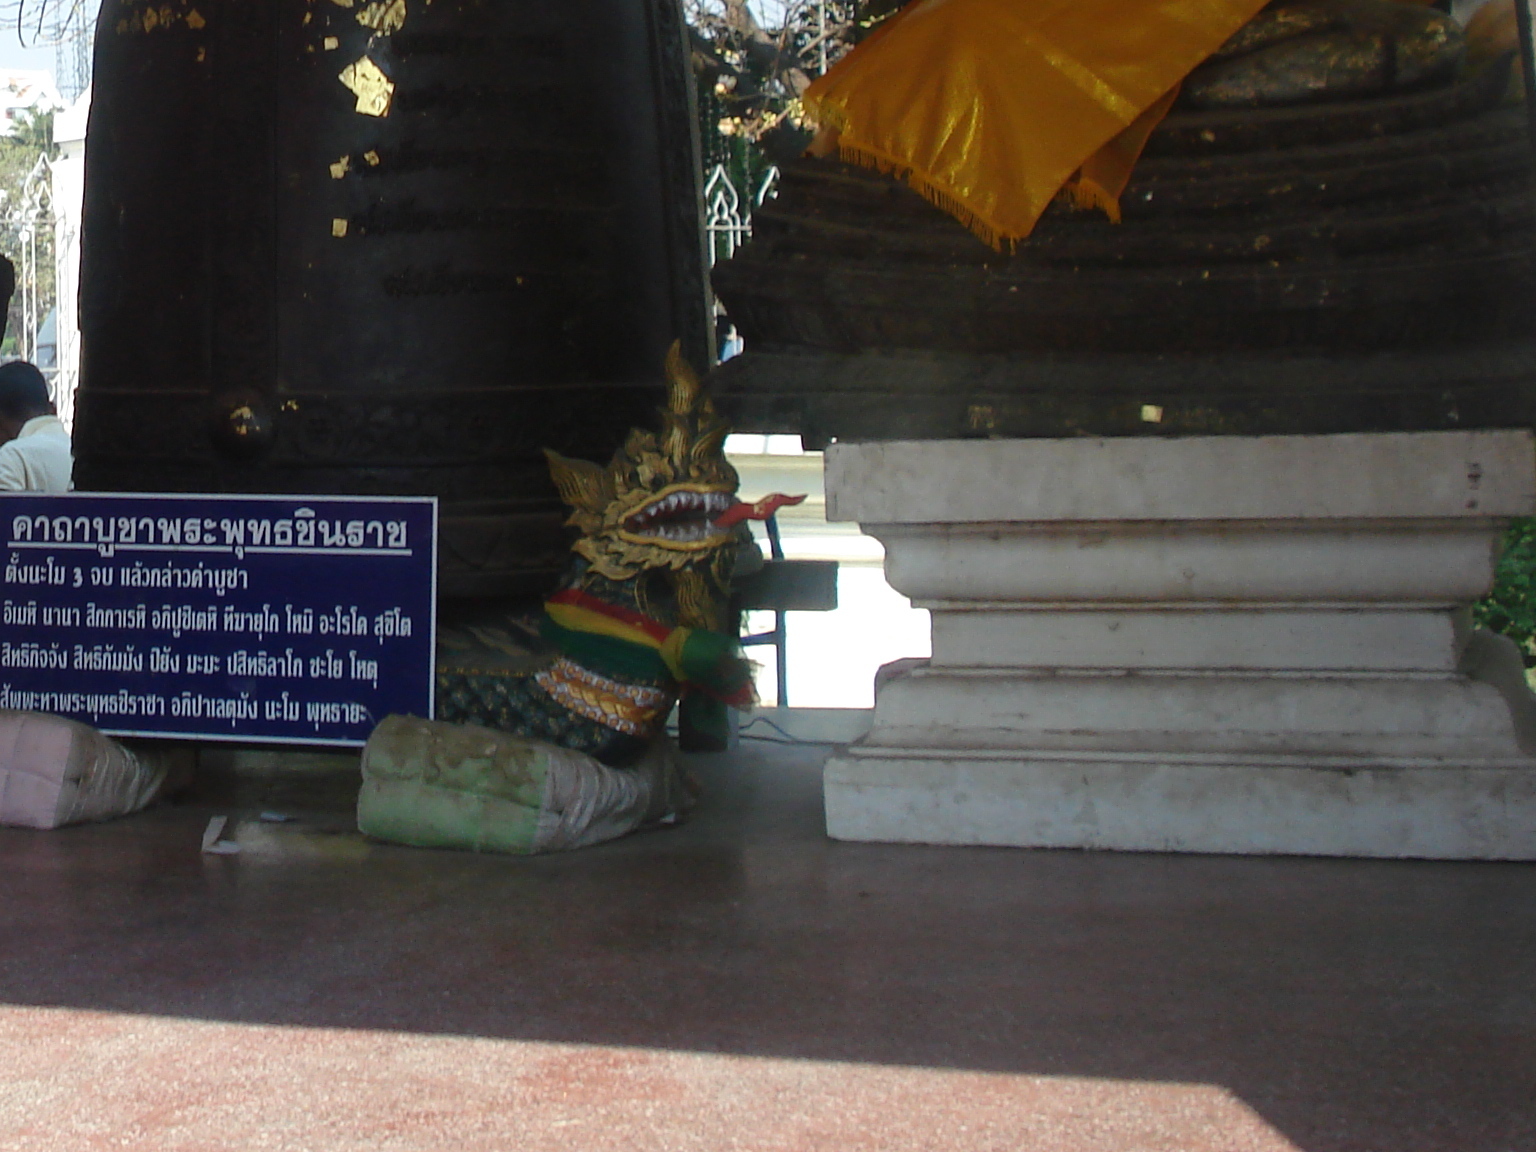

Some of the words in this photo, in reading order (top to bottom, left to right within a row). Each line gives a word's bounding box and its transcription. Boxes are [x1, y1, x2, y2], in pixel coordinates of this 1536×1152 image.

[12, 507, 407, 559] คาถาบูชาพระพุทธชินราช
[5, 552, 66, 585] ตั้งนะโม
[72, 567, 83, 588] 3
[90, 566, 114, 586] จบ
[3, 600, 37, 625] อิเมหิ
[43, 607, 80, 627] นานา
[285, 605, 313, 634] โหมิ
[319, 605, 368, 636] อะโรโค
[374, 607, 412, 645] สุขิโต
[1, 642, 68, 669] สิทธิกิจจัง
[73, 644, 143, 672] สิทธิกัมมัง
[149, 645, 180, 673] ปิยัง
[186, 654, 220, 675] มะมะ
[309, 649, 343, 679] ชะโย
[265, 691, 300, 721] นะโม
[306, 704, 367, 731] พุทธายะ
